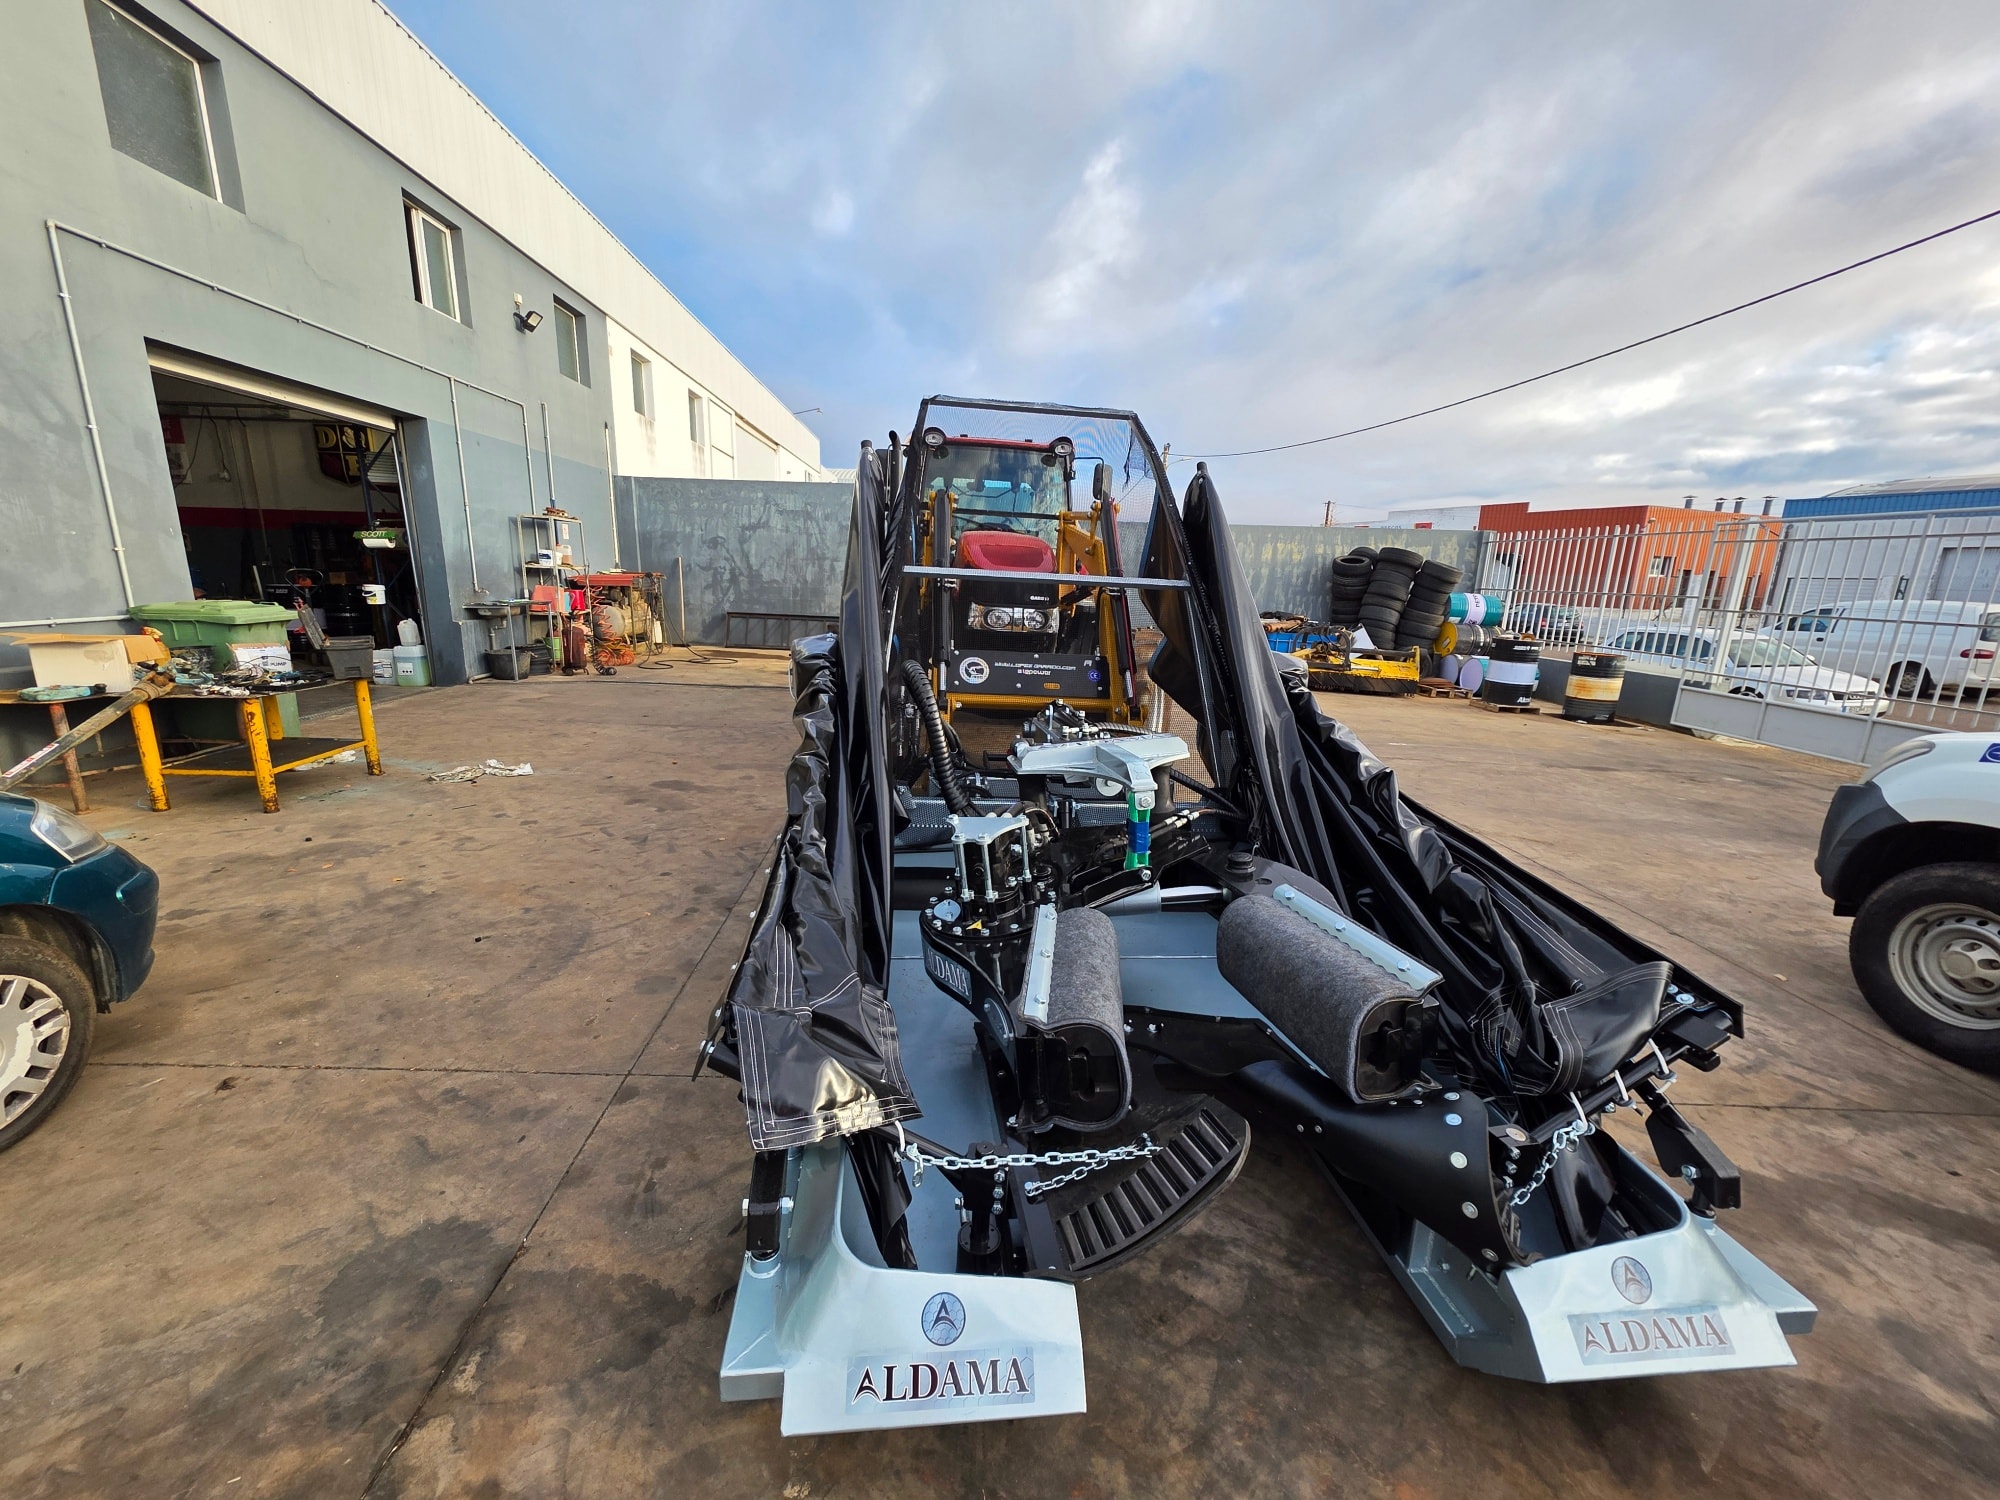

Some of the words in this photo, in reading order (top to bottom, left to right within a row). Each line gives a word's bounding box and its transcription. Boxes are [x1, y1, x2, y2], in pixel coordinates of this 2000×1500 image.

[926, 948, 970, 997] ALDAMA
[1584, 1314, 1728, 1355] ALDAMA
[851, 1356, 1030, 1403] ALDAMA
